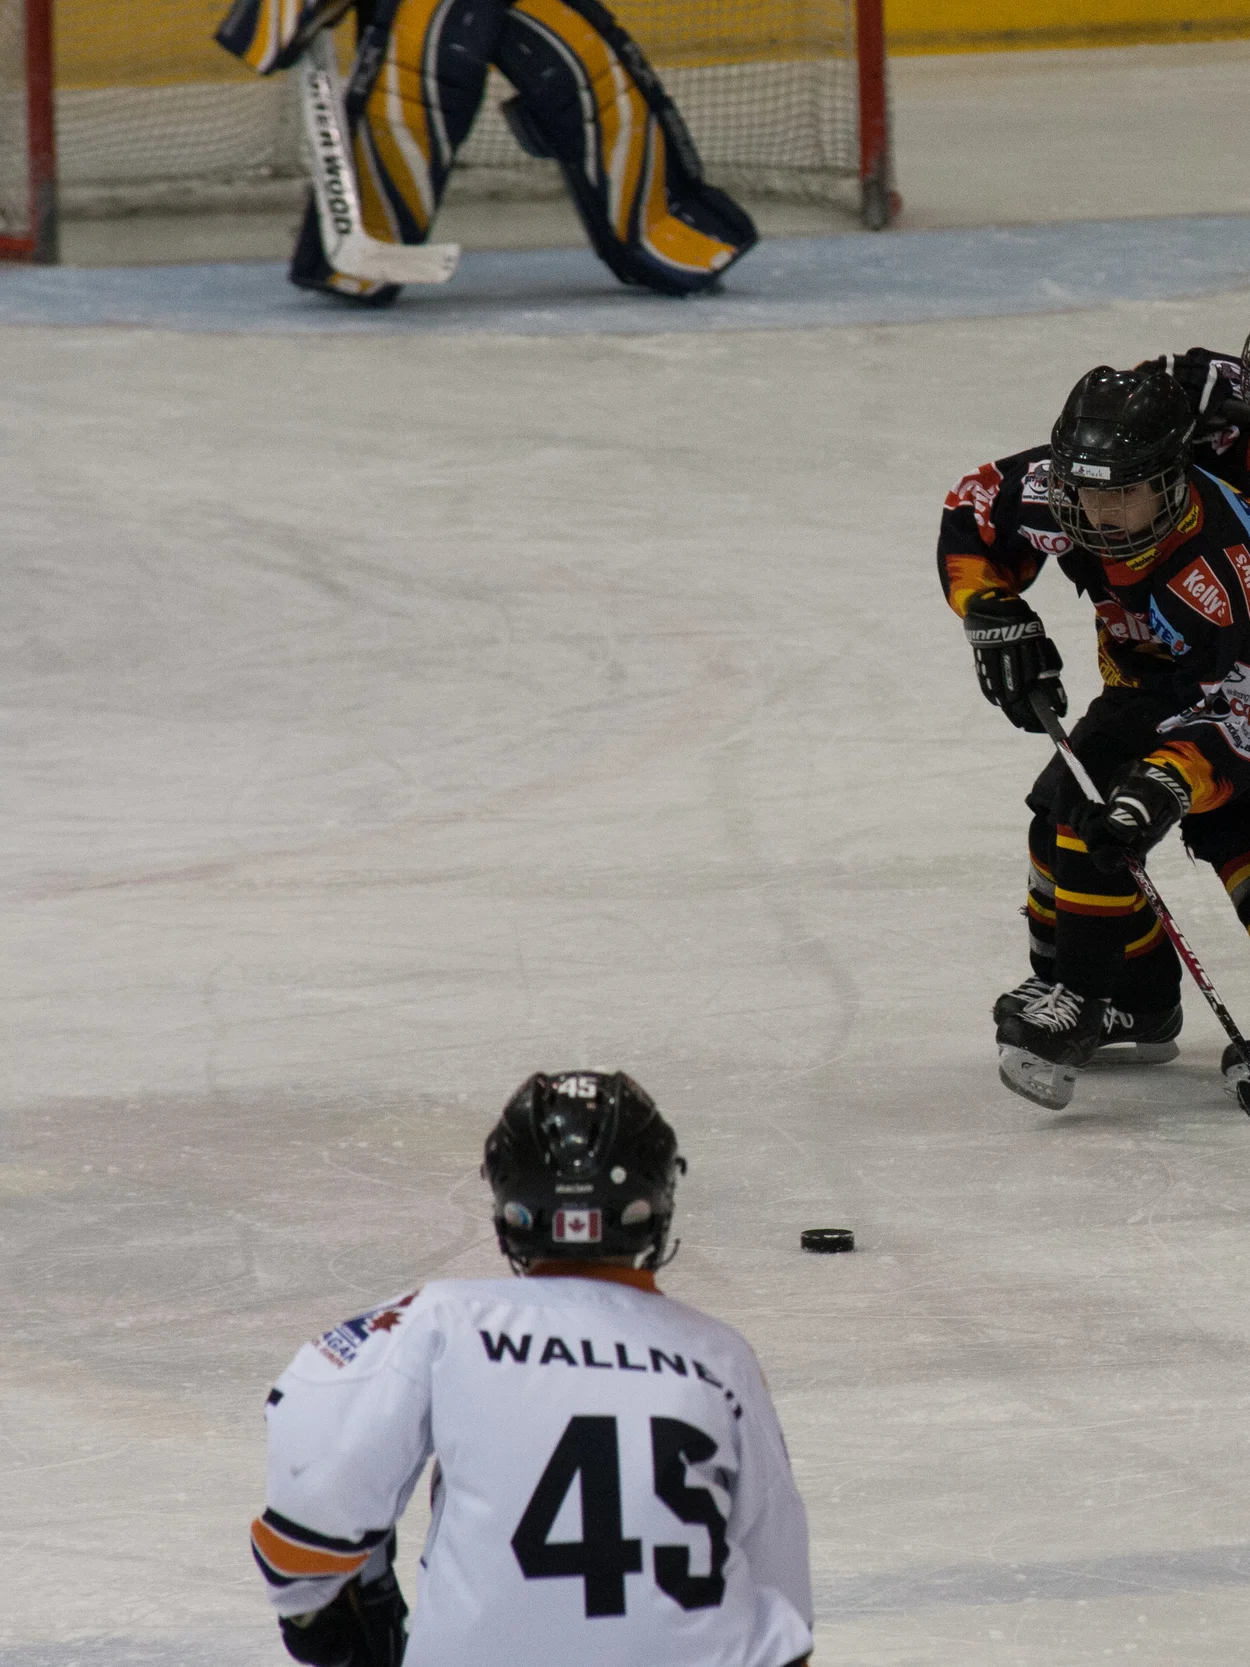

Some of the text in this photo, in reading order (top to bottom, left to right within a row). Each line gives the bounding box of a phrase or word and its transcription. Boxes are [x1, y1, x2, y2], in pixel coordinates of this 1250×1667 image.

[1183, 568, 1225, 618] Kelly's
[558, 1076, 598, 1098] 45
[511, 1414, 732, 1620] 45
